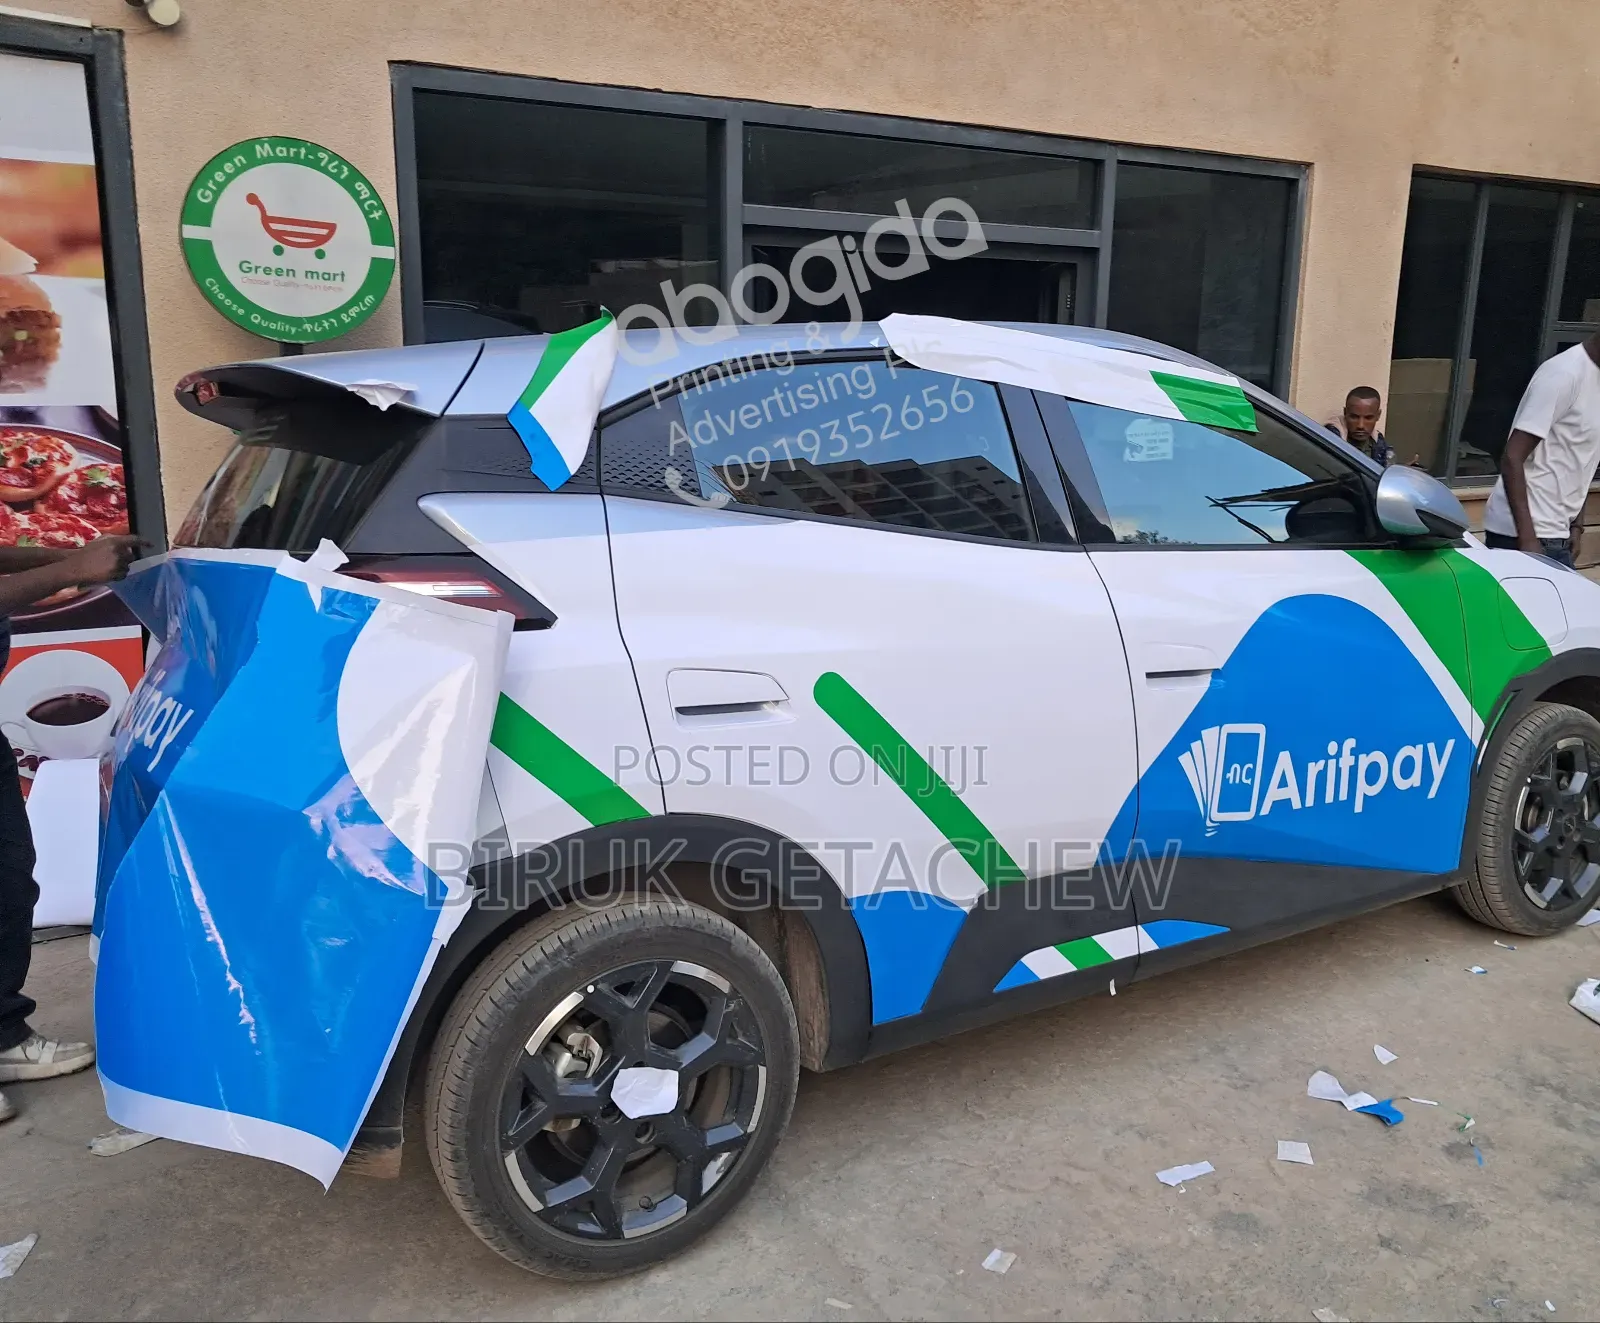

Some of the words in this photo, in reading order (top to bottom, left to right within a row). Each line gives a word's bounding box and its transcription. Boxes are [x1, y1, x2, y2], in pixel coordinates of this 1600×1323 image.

[197, 155, 247, 203] Green
[238, 260, 296, 278] Green
[304, 269, 346, 283] mart
[205, 278, 245, 316] Choose
[1259, 738, 1456, 816] Arifpay
